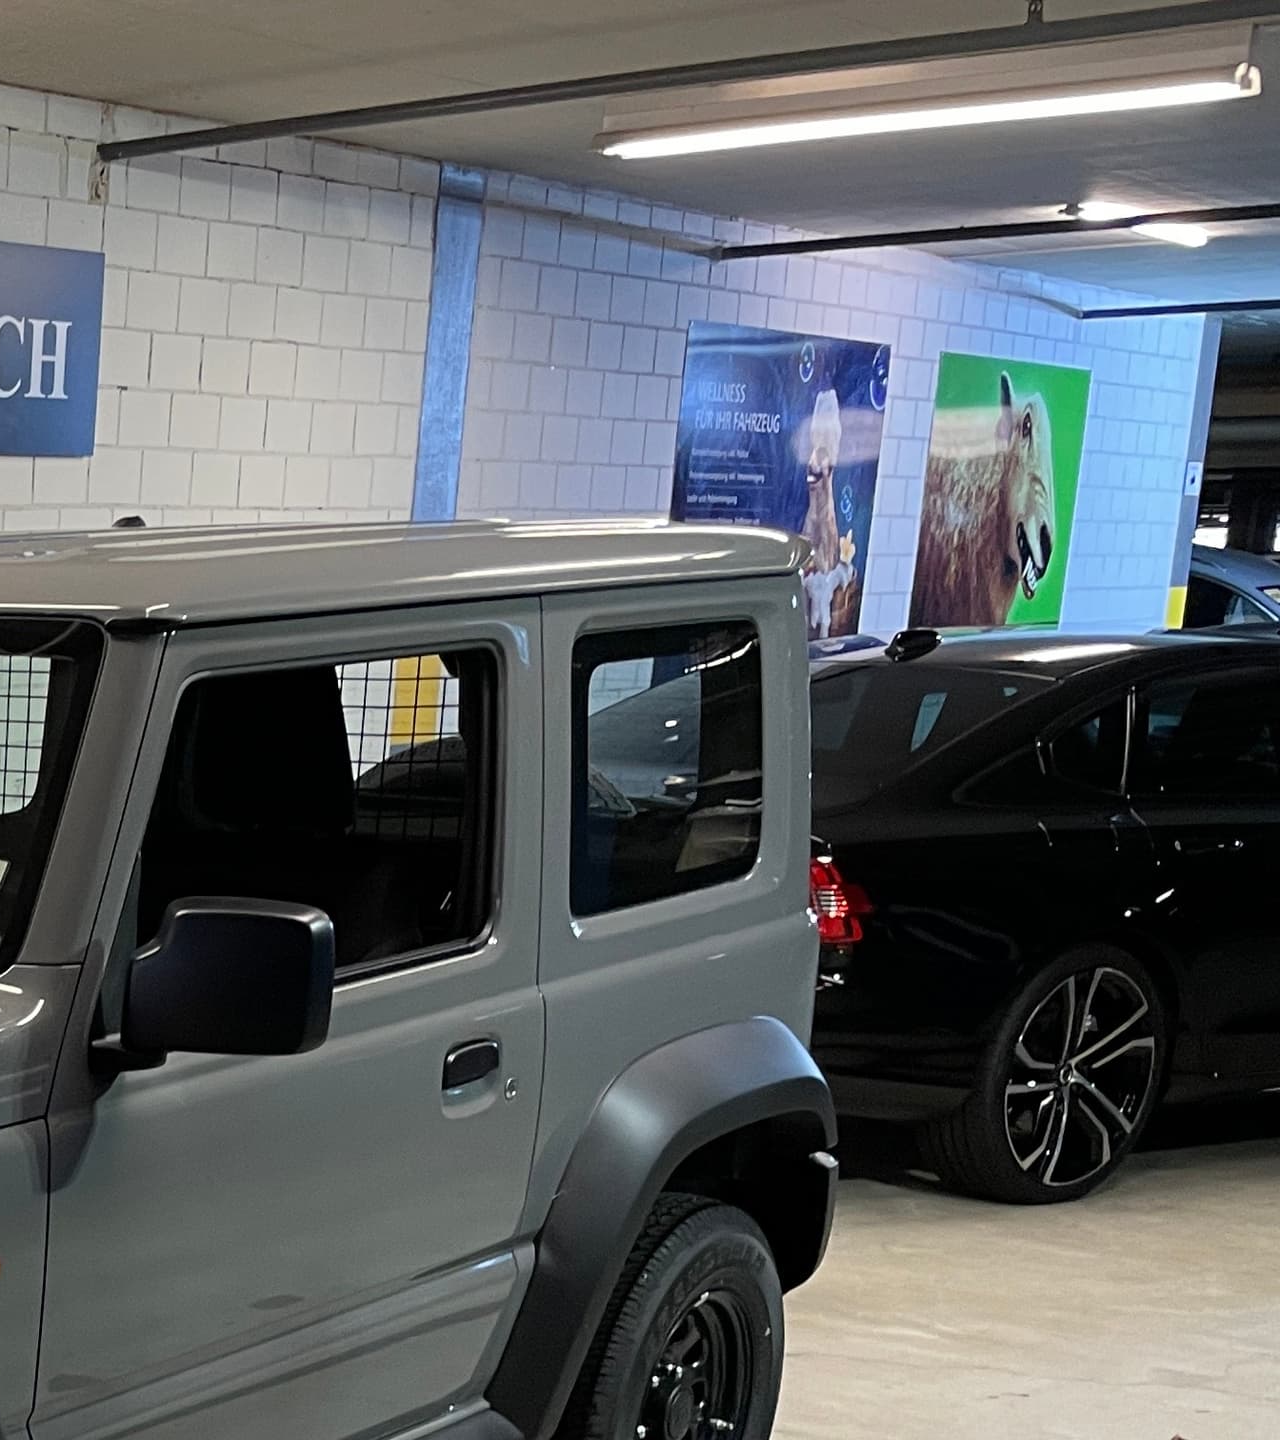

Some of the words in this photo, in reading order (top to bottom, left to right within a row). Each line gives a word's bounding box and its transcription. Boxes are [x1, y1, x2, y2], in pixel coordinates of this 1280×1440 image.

[698, 382, 747, 403] WELLNESS
[715, 411, 731, 431] IHR
[733, 412, 781, 434] FAHRZEUG
